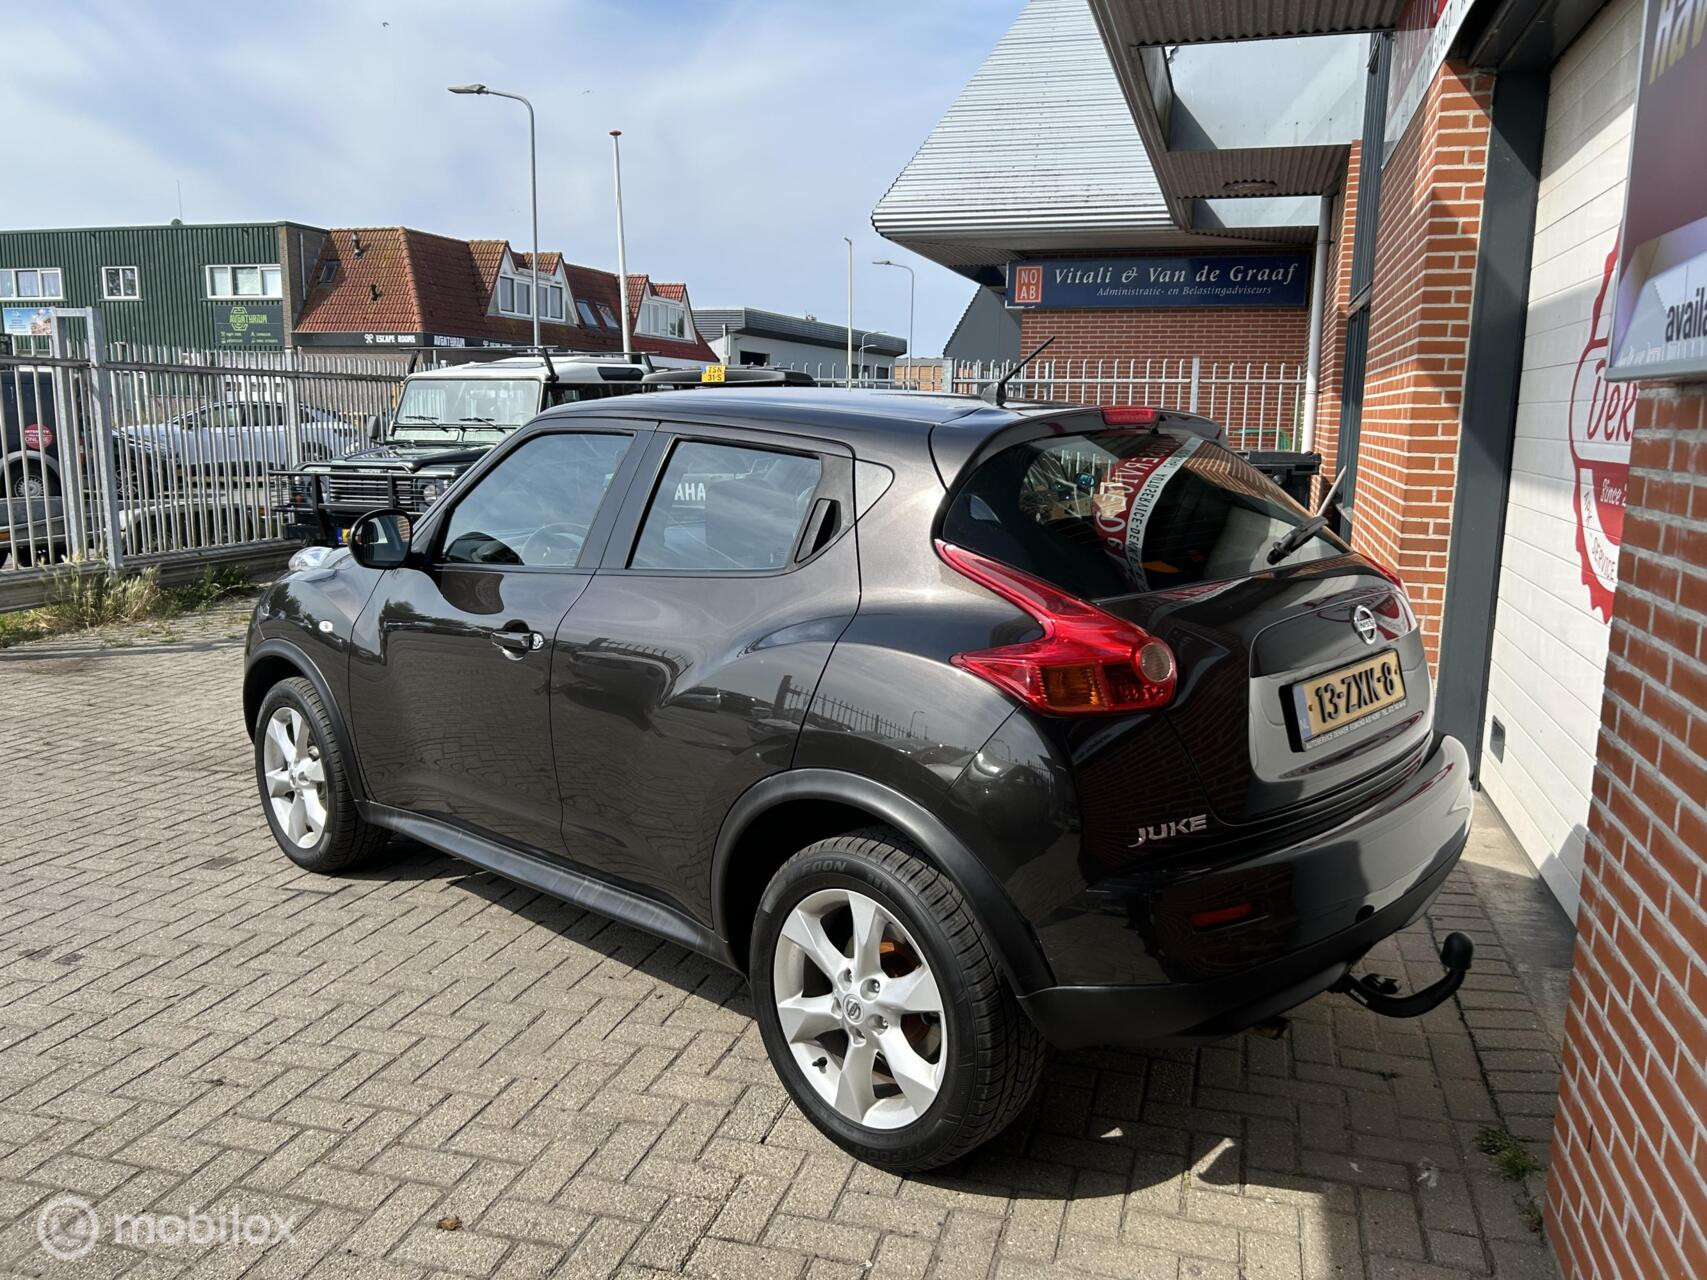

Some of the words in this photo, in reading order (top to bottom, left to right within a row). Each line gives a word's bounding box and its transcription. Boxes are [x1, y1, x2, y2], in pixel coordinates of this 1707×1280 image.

[1020, 269, 1038, 284] NO
[1055, 266, 1113, 284] Vitali
[1121, 266, 1138, 283] &
[1149, 267, 1187, 283] Van
[1195, 265, 1221, 282] de
[1229, 263, 1298, 285] Graaf
[1019, 285, 1037, 300] AB
[1097, 286, 1165, 297] Administratie-
[1168, 286, 1179, 296] en
[1182, 285, 1272, 297] Belastingadviseurs
[375, 334, 396, 343] ESCAPE
[397, 334, 416, 343] ROOMS
[1587, 359, 1638, 442] Dek
[1314, 661, 1395, 724] 13-ZXK-8
[1127, 814, 1208, 848] JUKE
